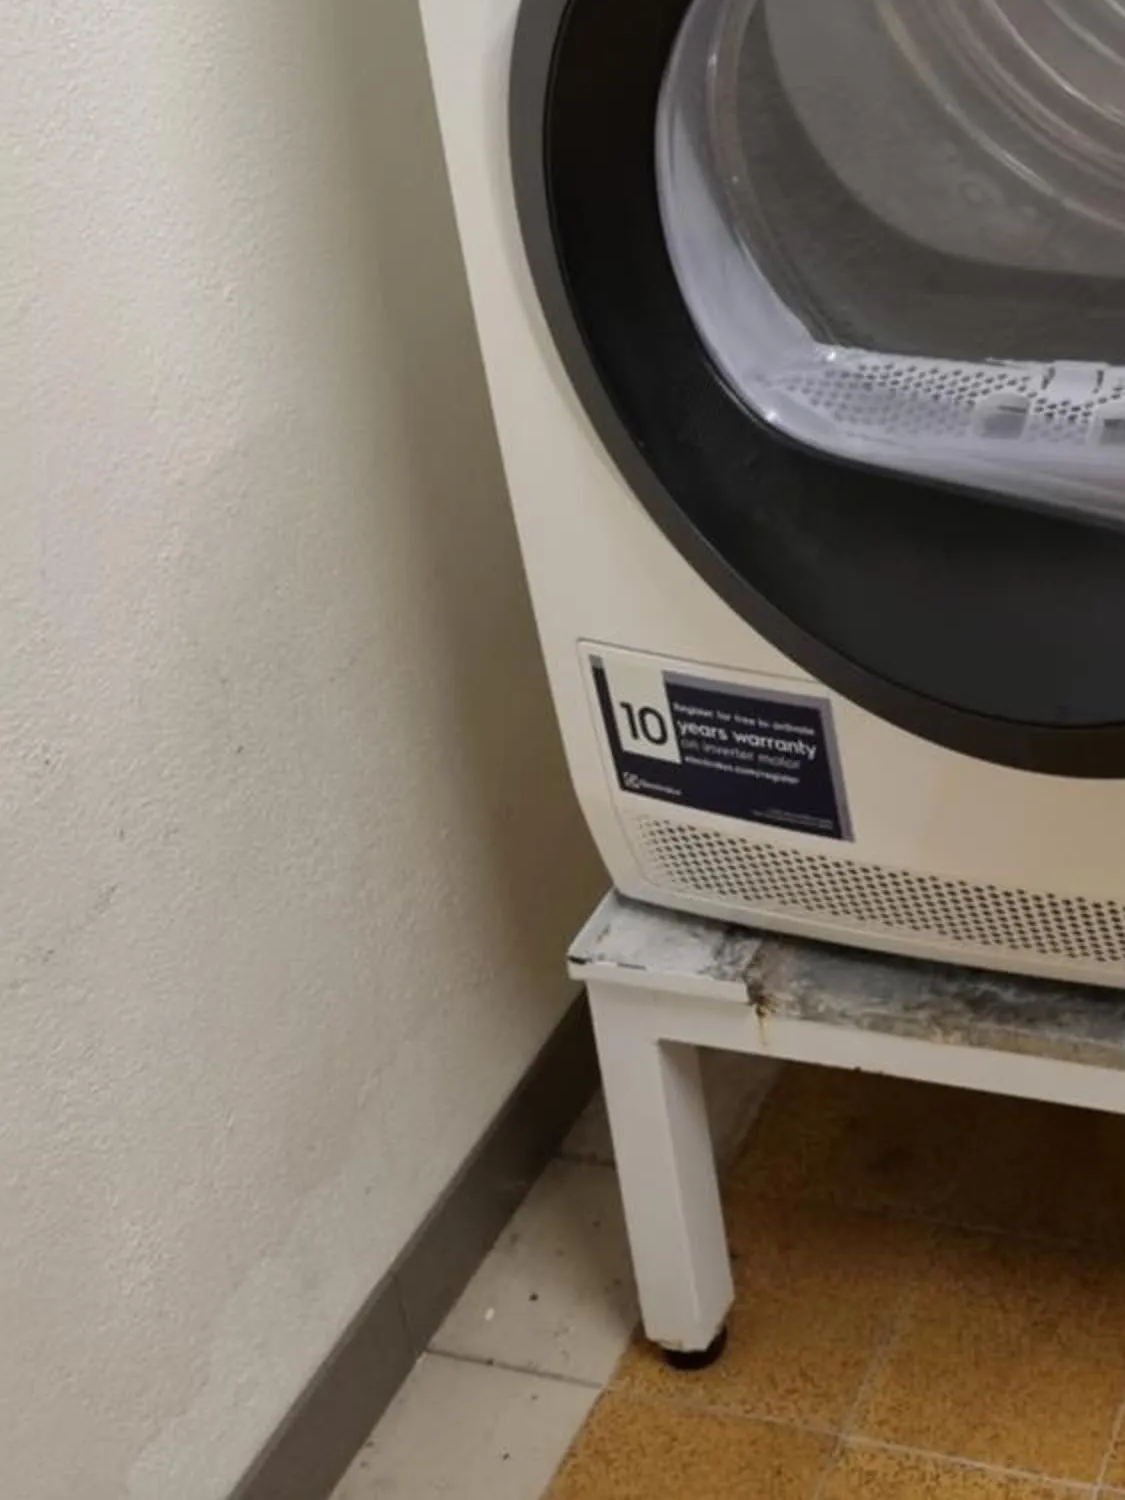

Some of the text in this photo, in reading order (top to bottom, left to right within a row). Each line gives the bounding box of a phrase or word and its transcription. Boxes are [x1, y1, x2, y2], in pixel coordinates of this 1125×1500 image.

[619, 701, 668, 746] 10
[676, 718, 818, 760] years warranty
[701, 740, 755, 763] inverter
[757, 752, 801, 771] motor
